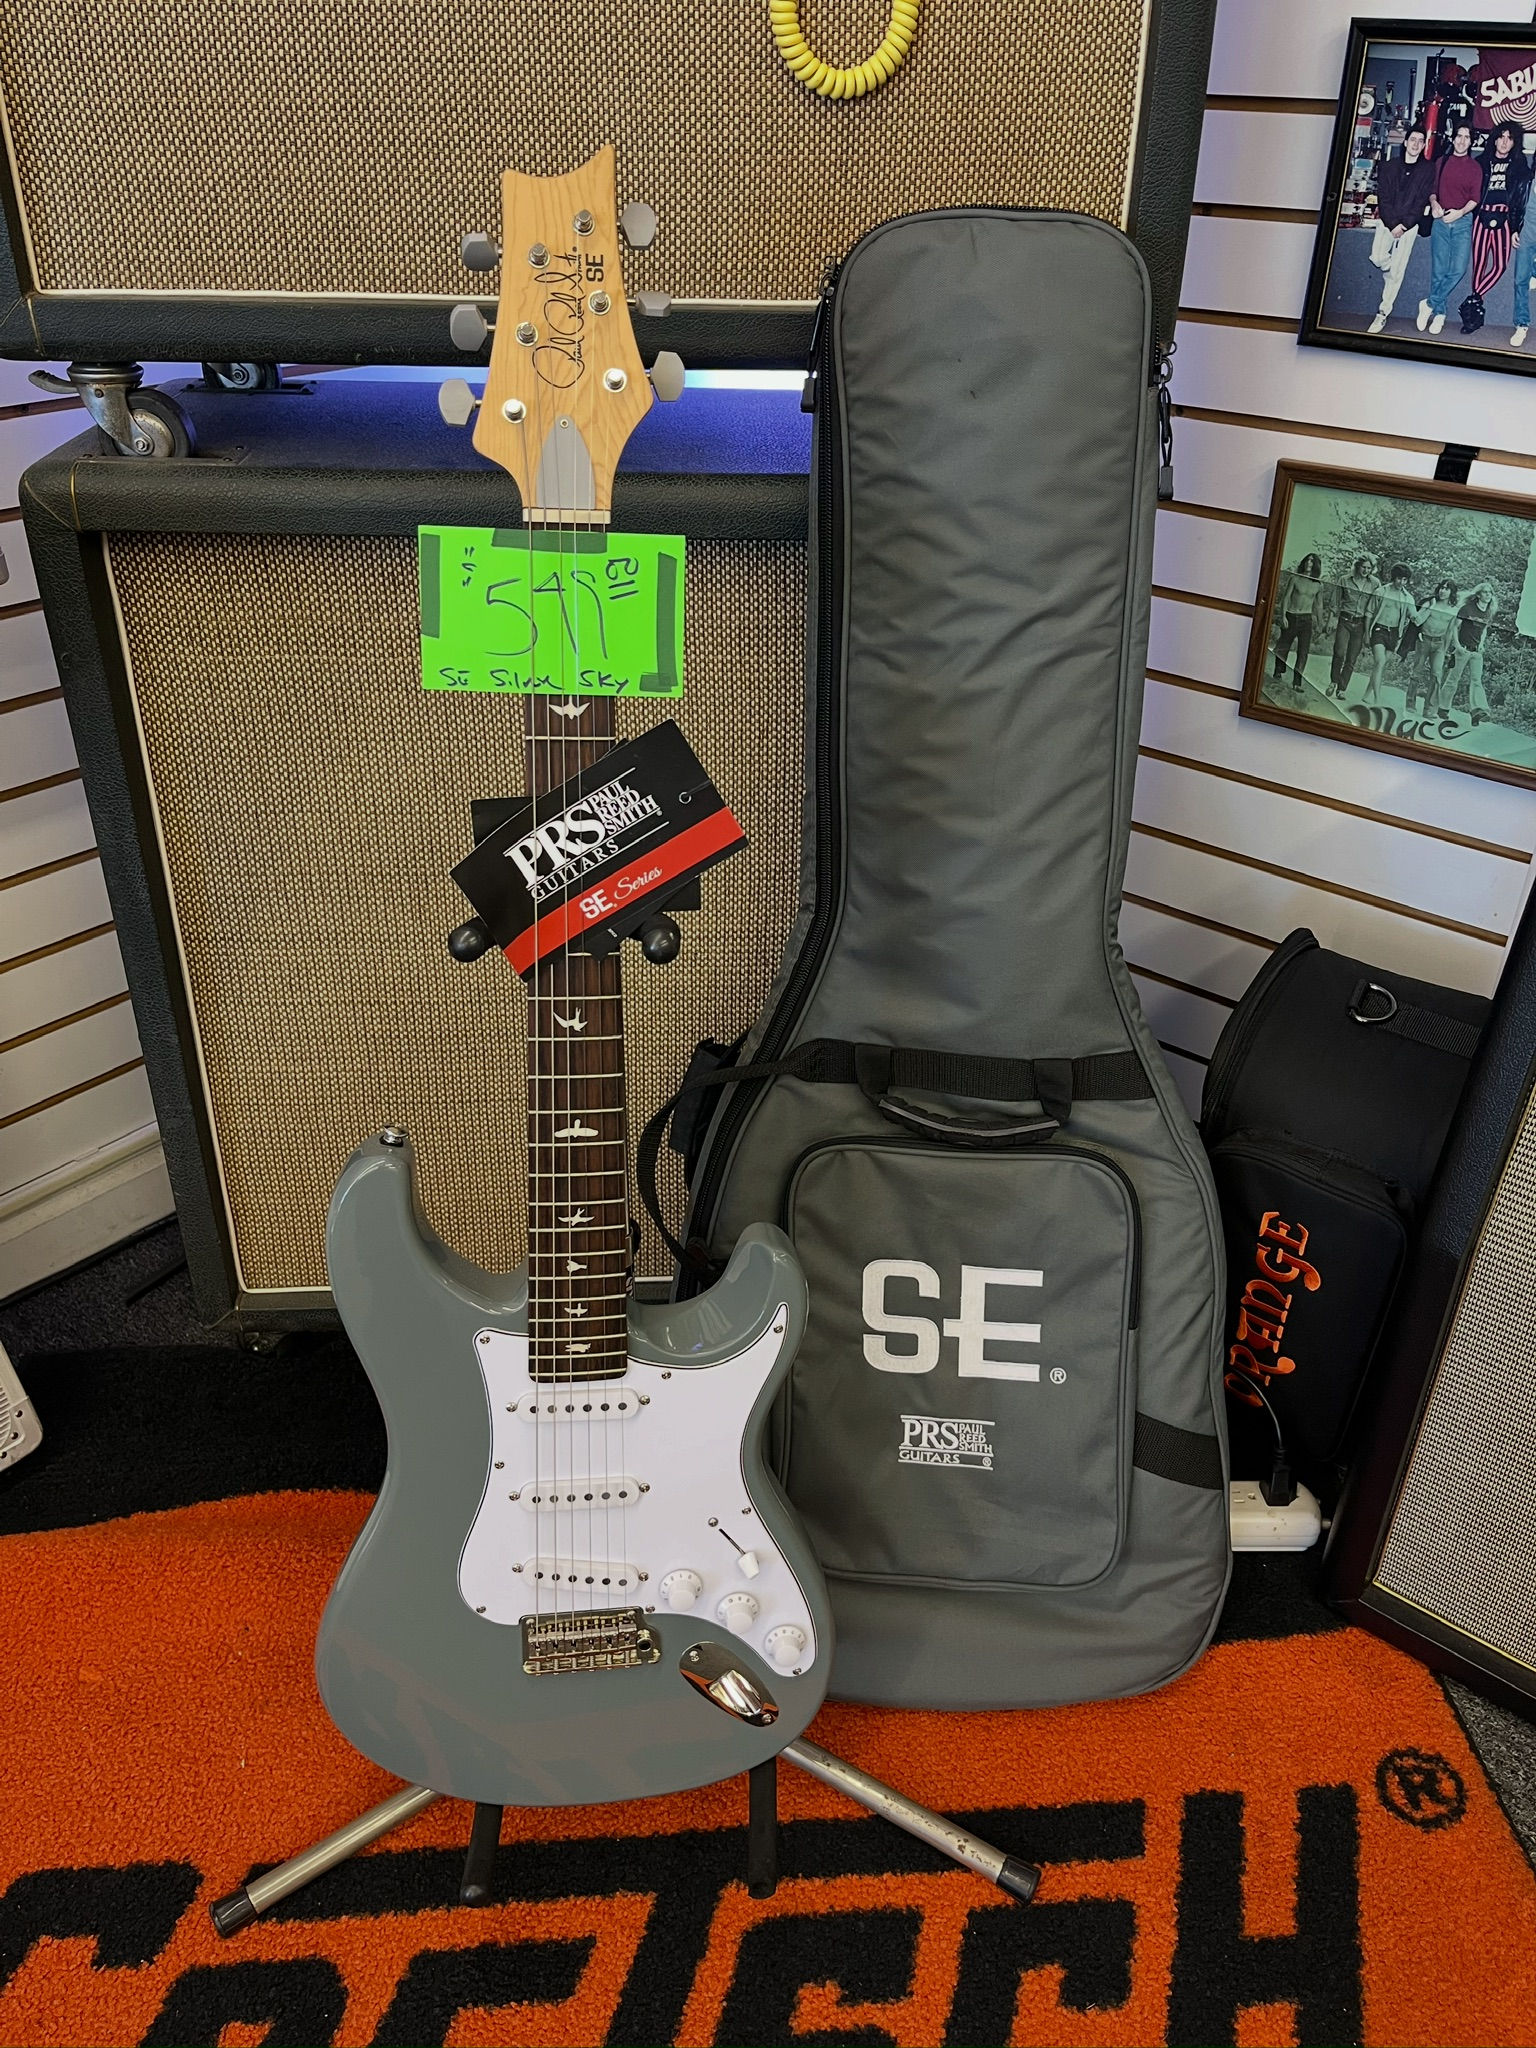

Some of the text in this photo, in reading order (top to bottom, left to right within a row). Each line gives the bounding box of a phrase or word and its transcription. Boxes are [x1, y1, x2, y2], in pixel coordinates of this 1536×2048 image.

[585, 253, 604, 282] SE
[579, 670, 629, 694] Sky
[1347, 704, 1471, 741] Mace
[586, 780, 631, 810] PAUL
[597, 789, 640, 823] REED
[604, 794, 661, 836] SMITH
[504, 800, 606, 889] PRS
[530, 838, 619, 899] GUITARS
[579, 866, 662, 919] SE Series
[862, 1259, 1044, 1382] SE
[901, 1419, 959, 1450] PRS
[959, 1423, 986, 1435] PAUL
[959, 1433, 987, 1444] REED
[899, 1450, 960, 1464] GUITARS
[958, 1442, 993, 1453] SMITH
